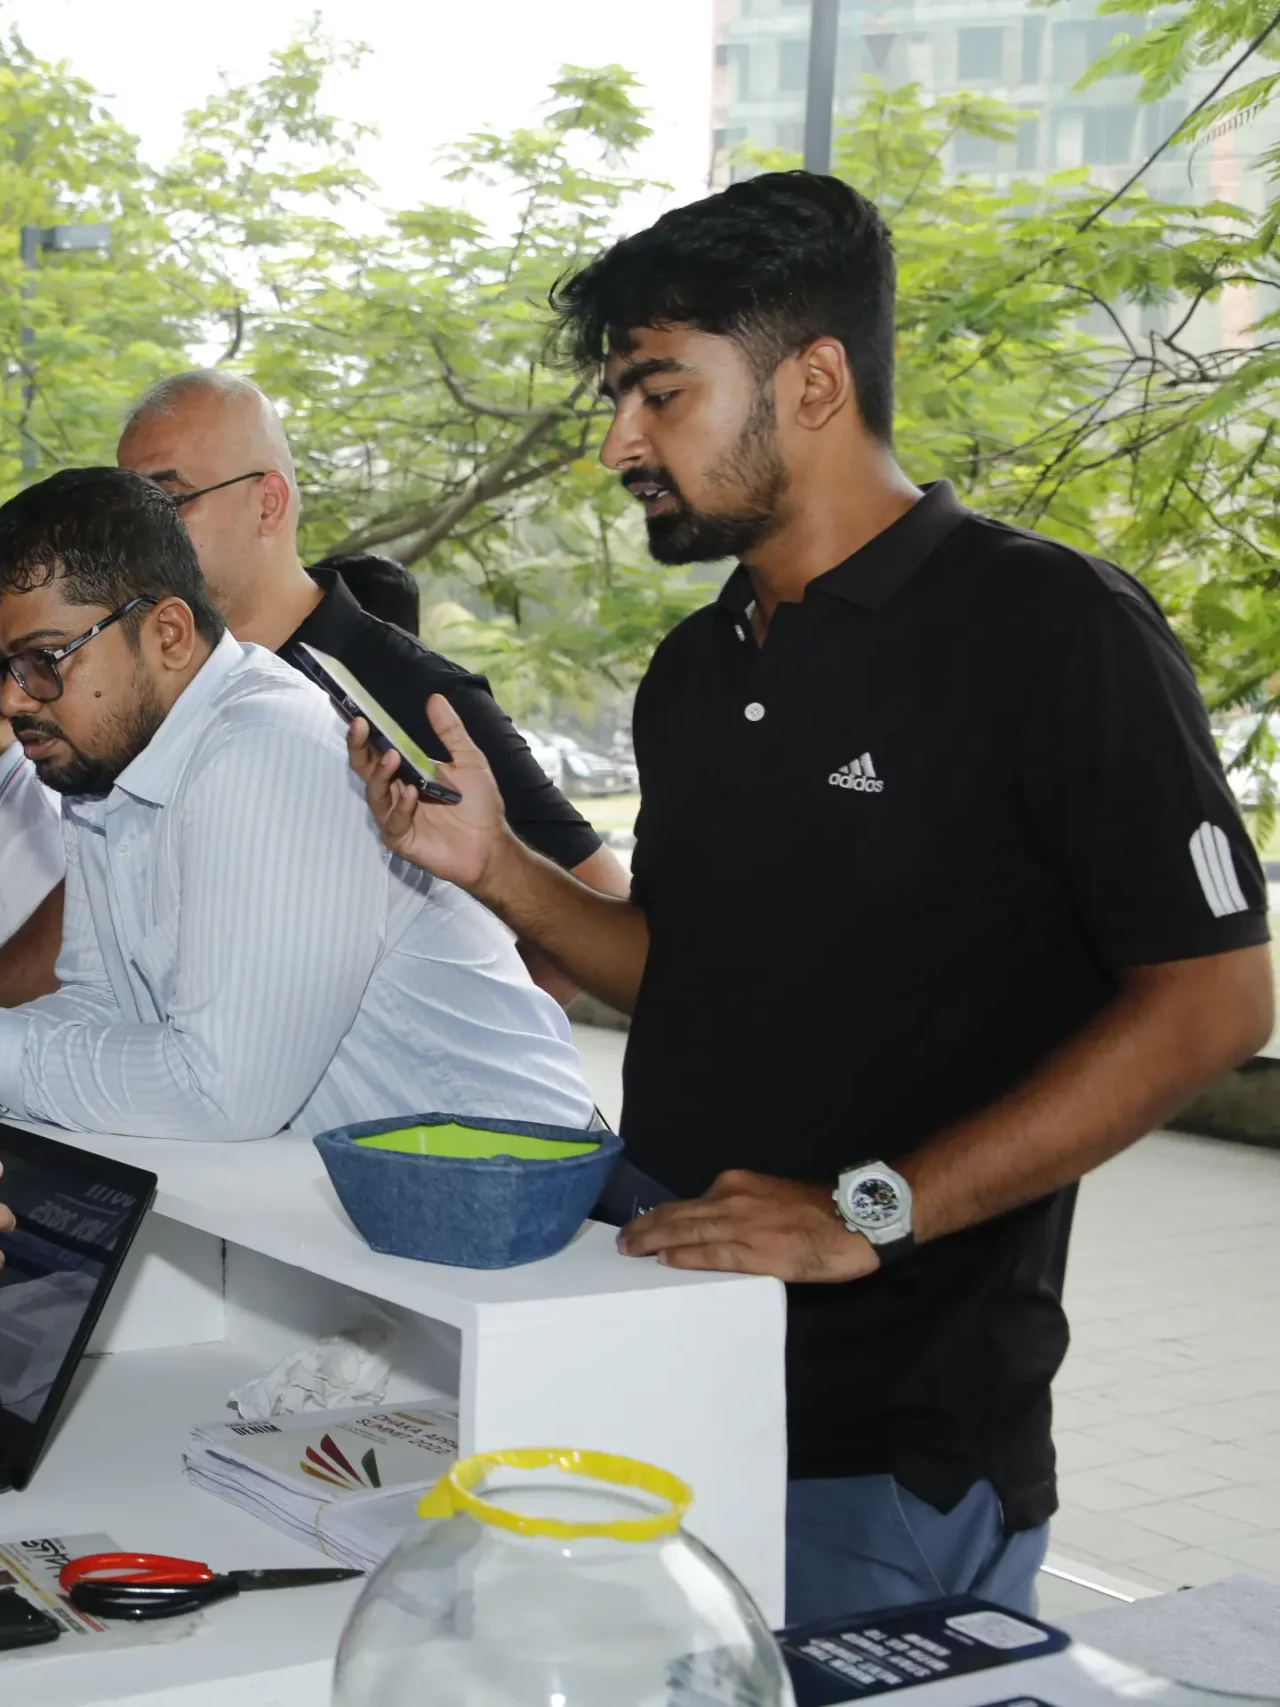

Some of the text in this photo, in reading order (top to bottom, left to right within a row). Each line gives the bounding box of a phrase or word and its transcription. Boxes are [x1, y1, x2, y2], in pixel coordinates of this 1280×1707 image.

[828, 772, 884, 793] adidas
[372, 1414, 423, 1434] DHAKA
[356, 1418, 413, 1439] SUMMIT
[408, 1438, 451, 1455] 2022
